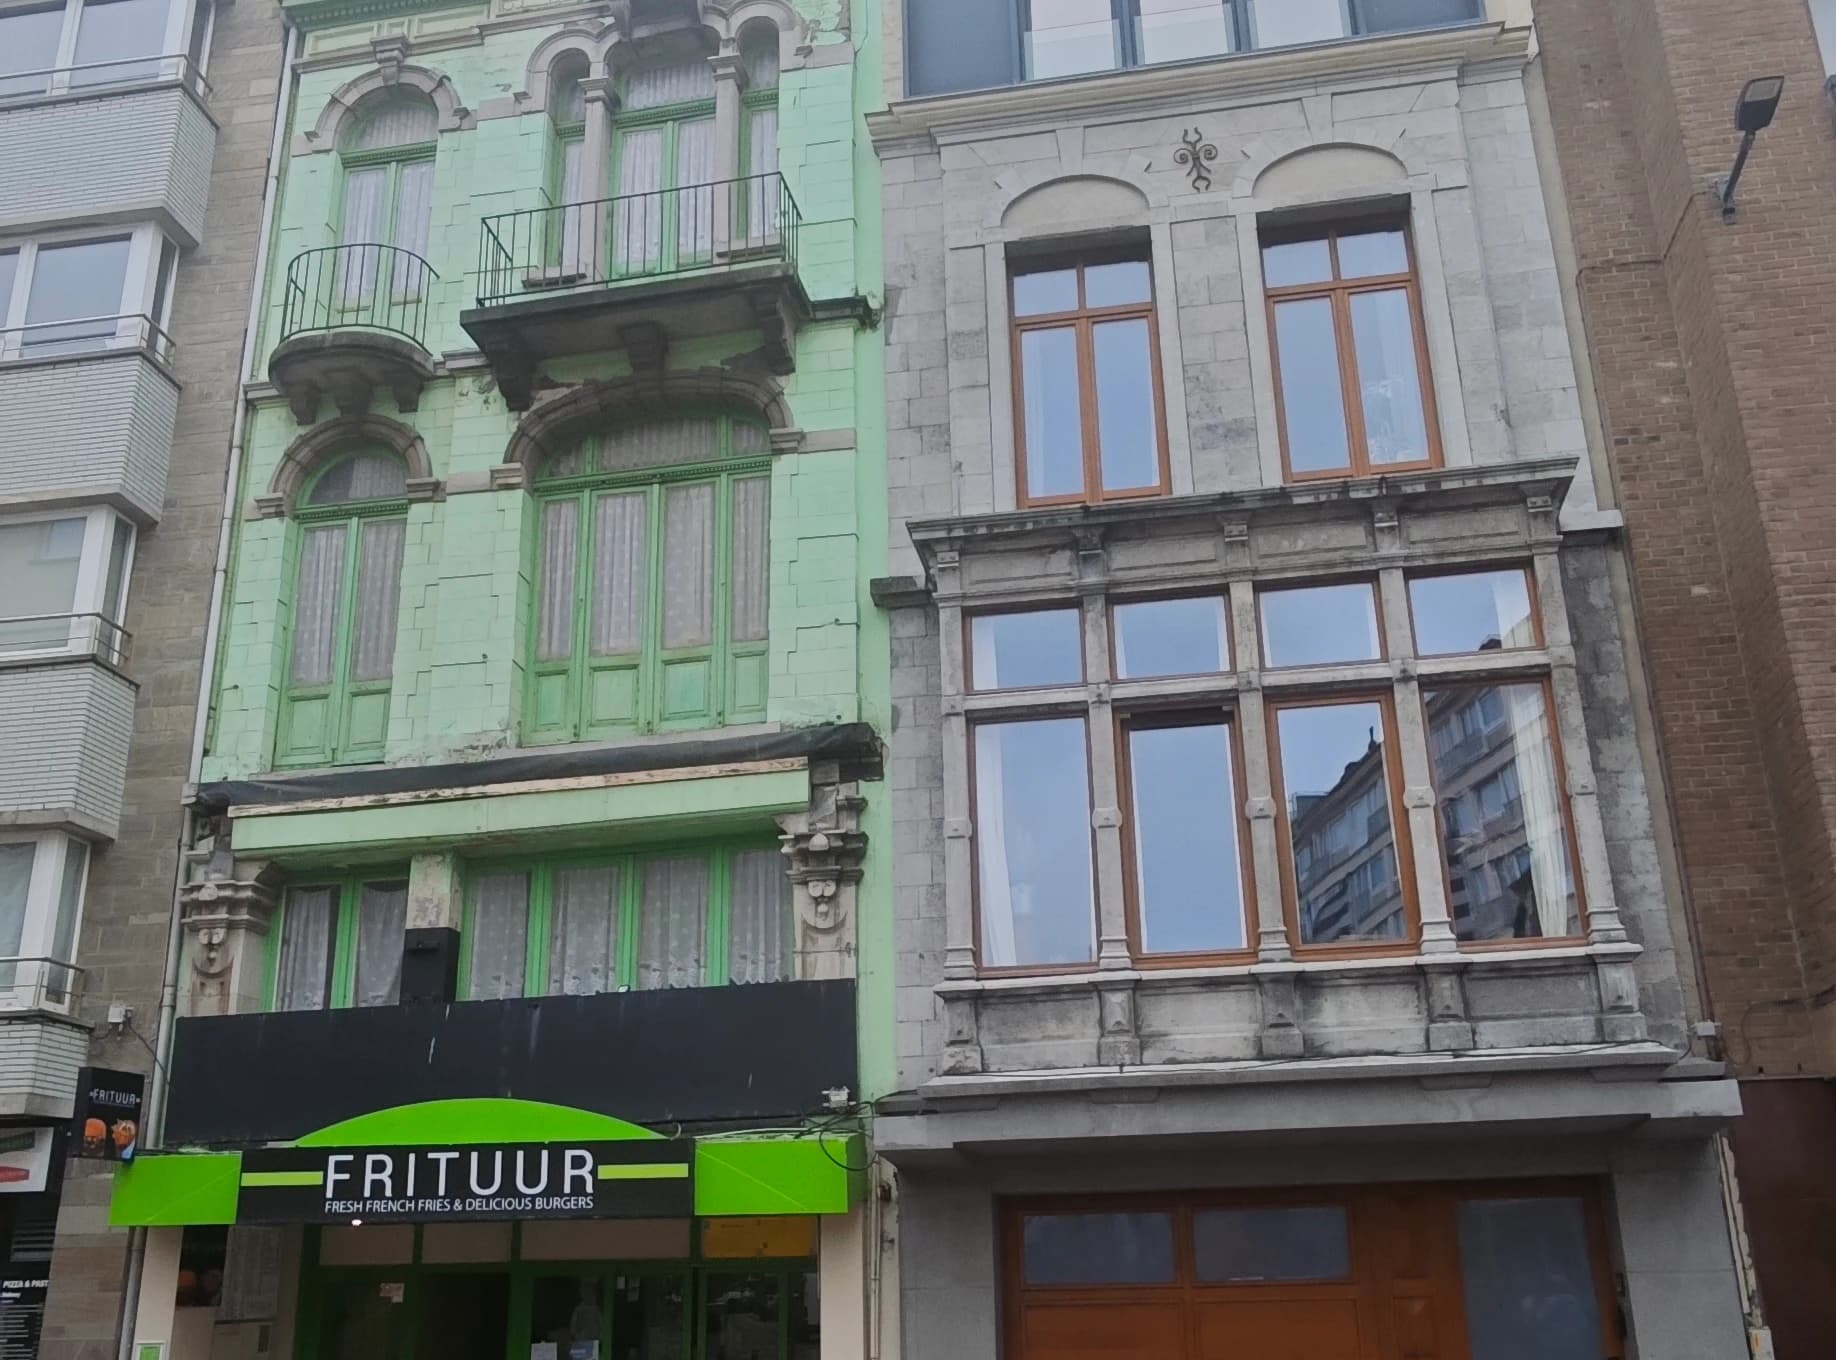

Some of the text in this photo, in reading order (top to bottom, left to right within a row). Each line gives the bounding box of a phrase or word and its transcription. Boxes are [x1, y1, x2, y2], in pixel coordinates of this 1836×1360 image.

[93, 1088, 136, 1105] FRITUUR
[325, 1148, 594, 1199] FRITUUR
[325, 1196, 594, 1214] FRESH FRENCH FRIES & DELICIOUS BURGERS
